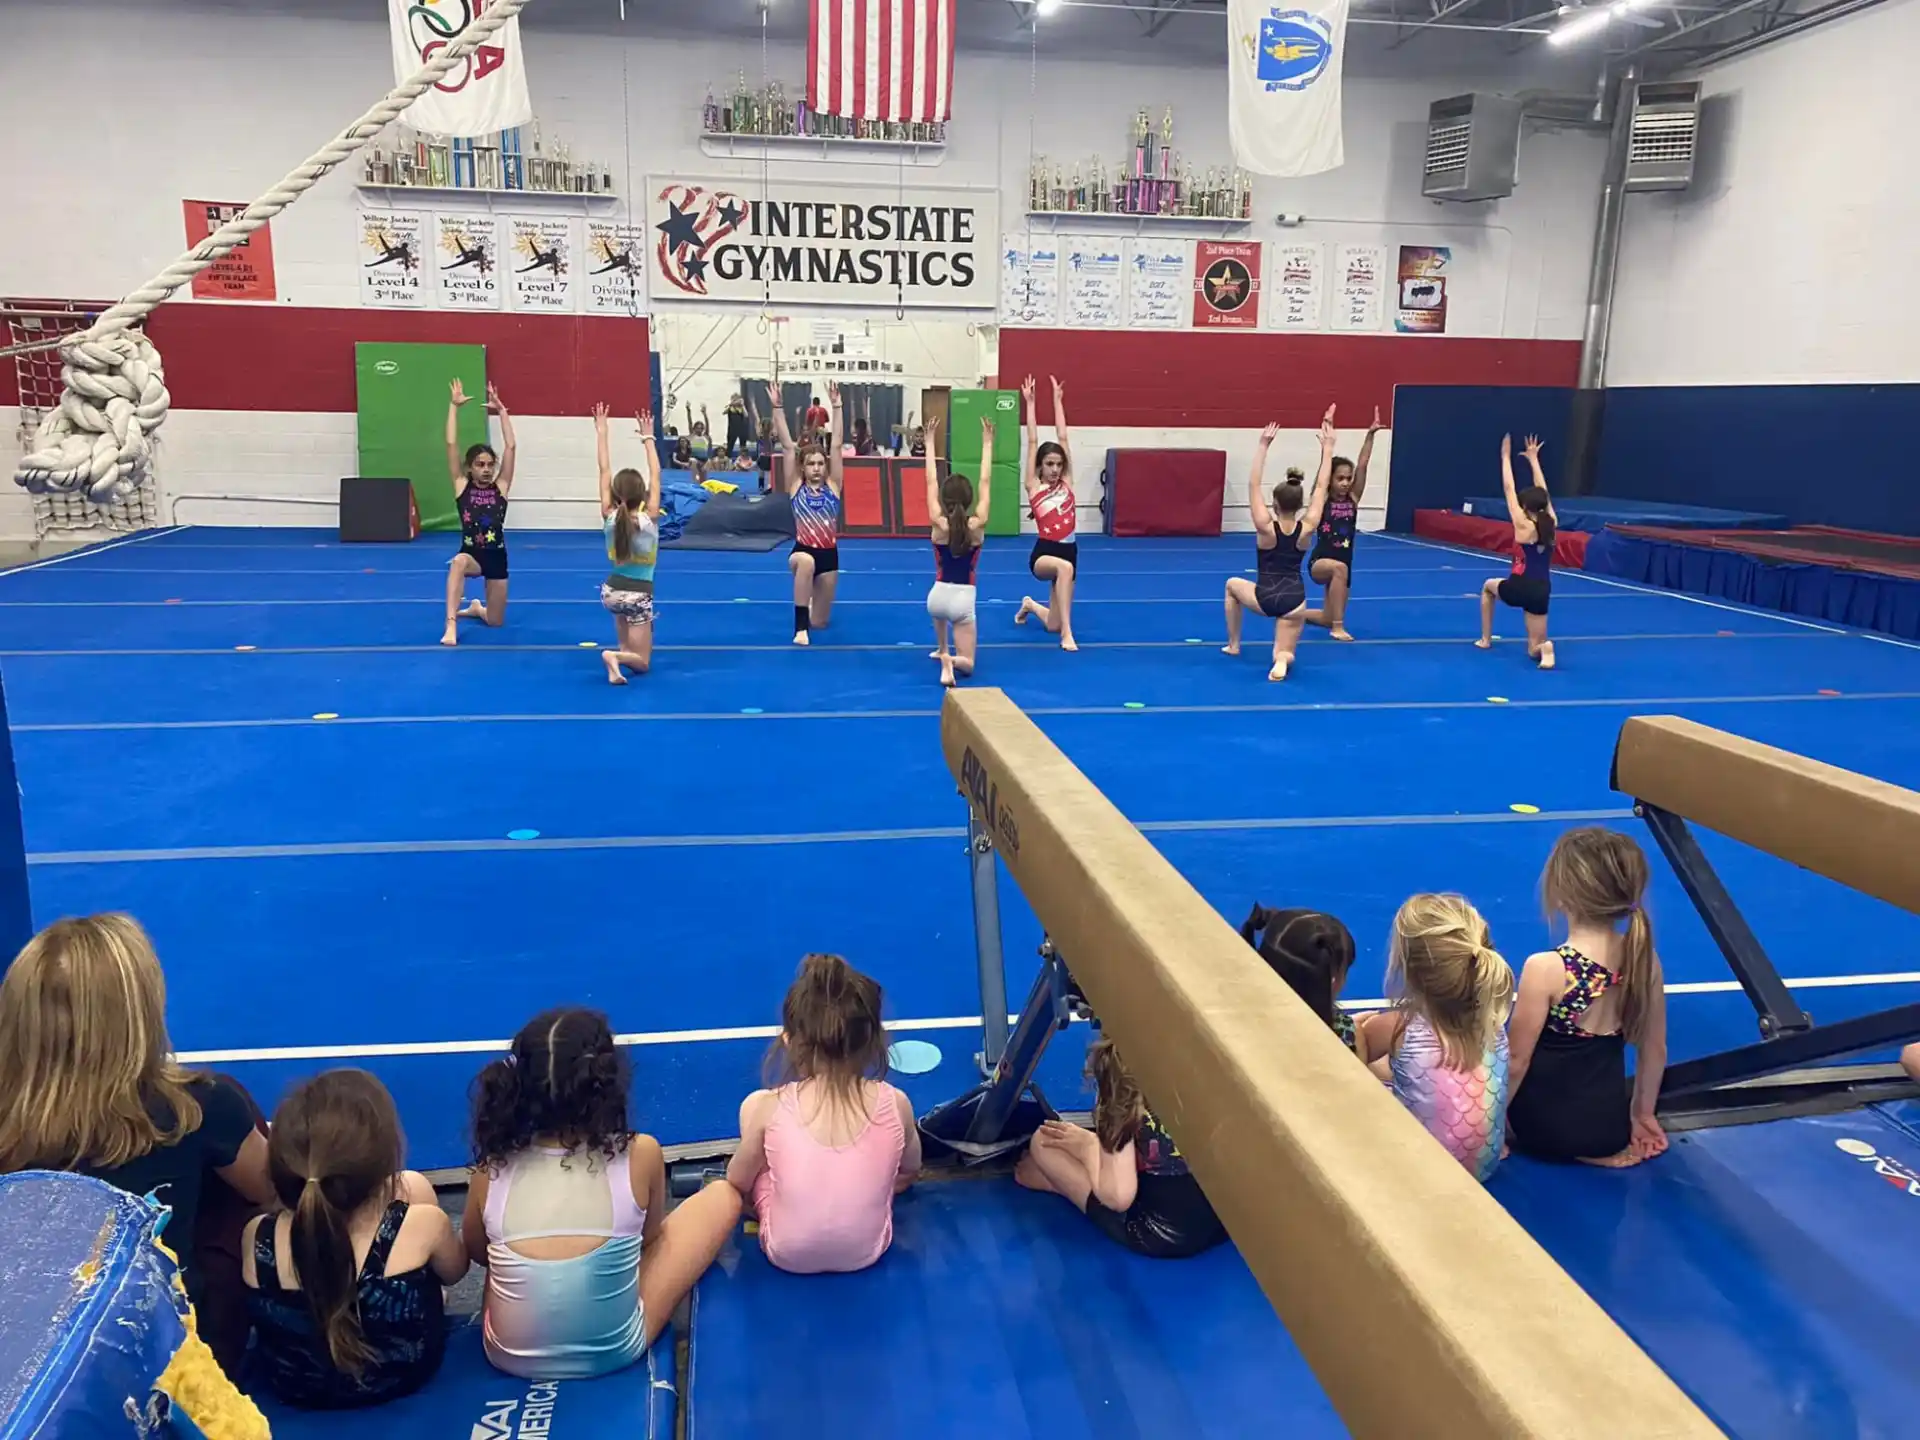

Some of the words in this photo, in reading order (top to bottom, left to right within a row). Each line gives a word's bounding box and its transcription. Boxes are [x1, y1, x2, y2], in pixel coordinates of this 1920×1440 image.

[391, 215, 419, 224] Jackets
[467, 219, 495, 227] Jackets
[750, 200, 975, 243] INTERSTATE
[540, 222, 568, 230] Jackets
[588, 223, 614, 231] Yellow
[614, 224, 642, 232] Jackets
[1218, 246, 1234, 255] Place
[713, 244, 975, 287] GYMNASTICS
[232, 274, 258, 282] PLACE
[367, 277, 405, 286] Level
[408, 276, 420, 288] 4
[443, 279, 481, 289] Level
[484, 279, 495, 290] 6
[517, 282, 555, 292] Level
[559, 282, 568, 292] 7
[374, 290, 390, 300] 3rd
[391, 290, 415, 300] Place
[449, 292, 465, 302] 3rd
[466, 292, 489, 302] Place
[523, 294, 540, 304] 2nd
[541, 295, 564, 305] Place
[596, 296, 612, 306] 2nd
[614, 298, 636, 307] Place
[1093, 310, 1108, 320] Gold
